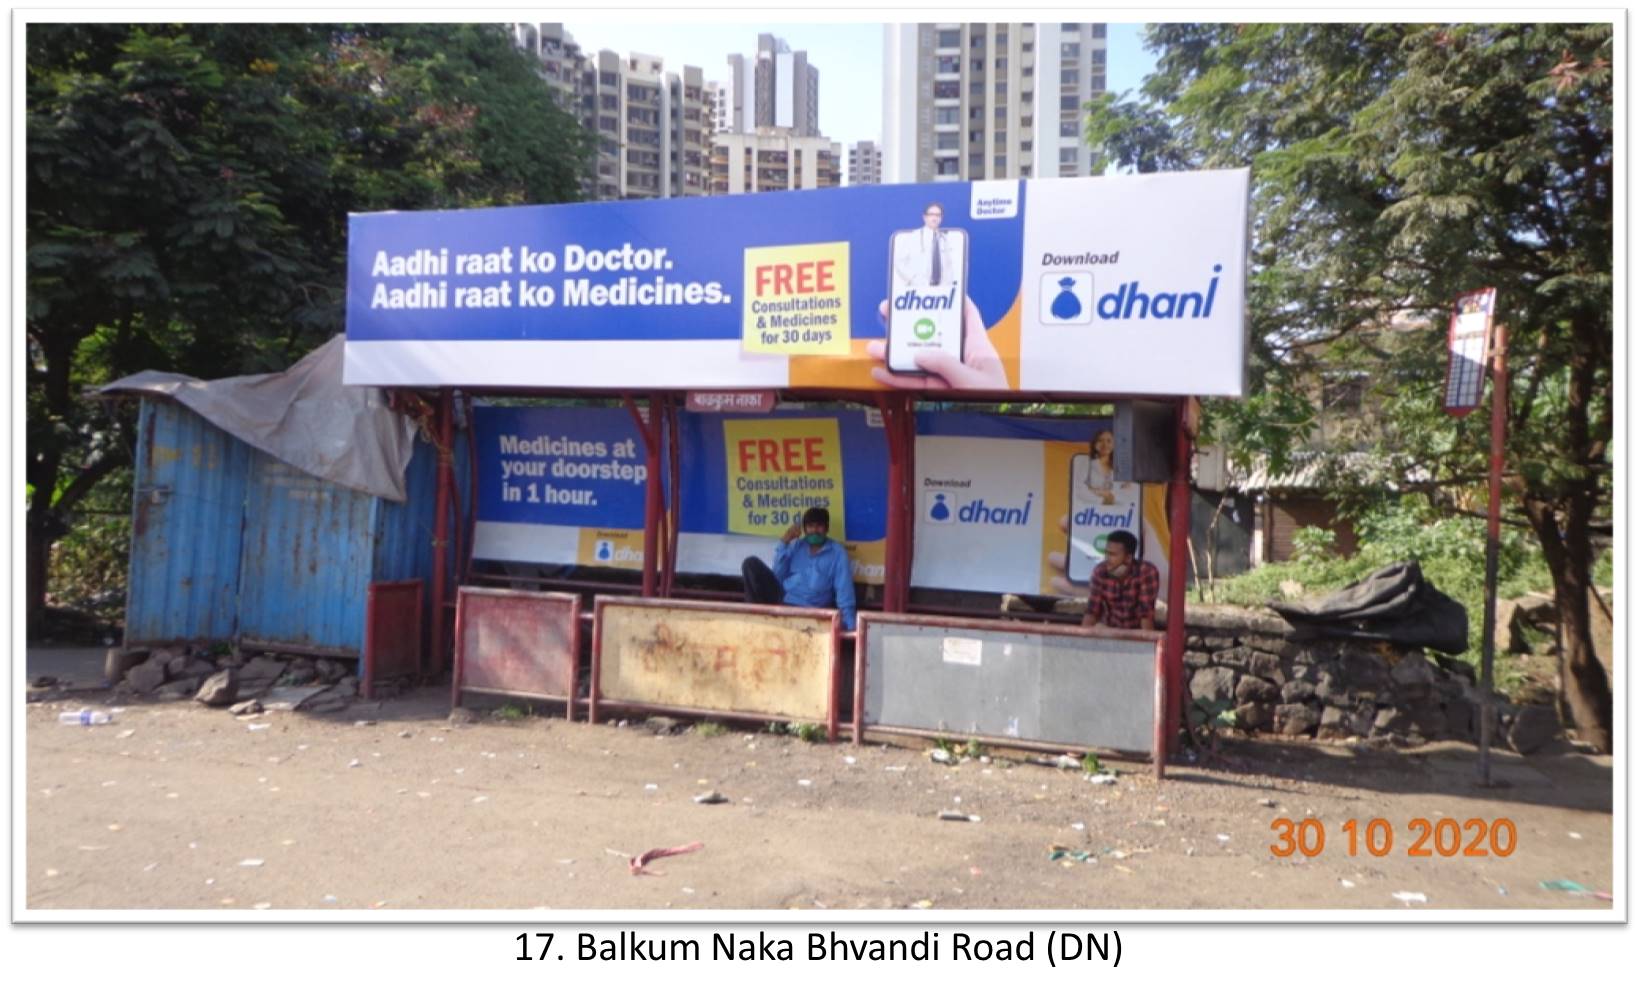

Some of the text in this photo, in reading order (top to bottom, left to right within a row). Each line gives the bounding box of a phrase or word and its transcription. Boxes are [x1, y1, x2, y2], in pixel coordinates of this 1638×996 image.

[371, 242, 674, 277] Aadhi raat ko Doctor.
[1041, 251, 1120, 266] Download
[755, 260, 836, 297] FREE
[1097, 263, 1223, 320] dhani
[370, 276, 732, 309] Aadhi raat ko Medicines.
[751, 297, 842, 314] Consultations
[894, 280, 958, 311] dhani
[756, 313, 838, 329] & Medicines
[761, 329, 832, 345] for 30 days
[499, 435, 637, 458] Medicines at
[737, 436, 827, 473] FREE
[501, 457, 647, 485] your doorstep
[736, 475, 834, 491] Consultations
[502, 481, 598, 506] in 1 hour.
[743, 493, 830, 509] & Medicines
[748, 510, 767, 525] for
[770, 510, 789, 525] 30
[958, 491, 1034, 526] dhani
[1074, 501, 1136, 529] dhani
